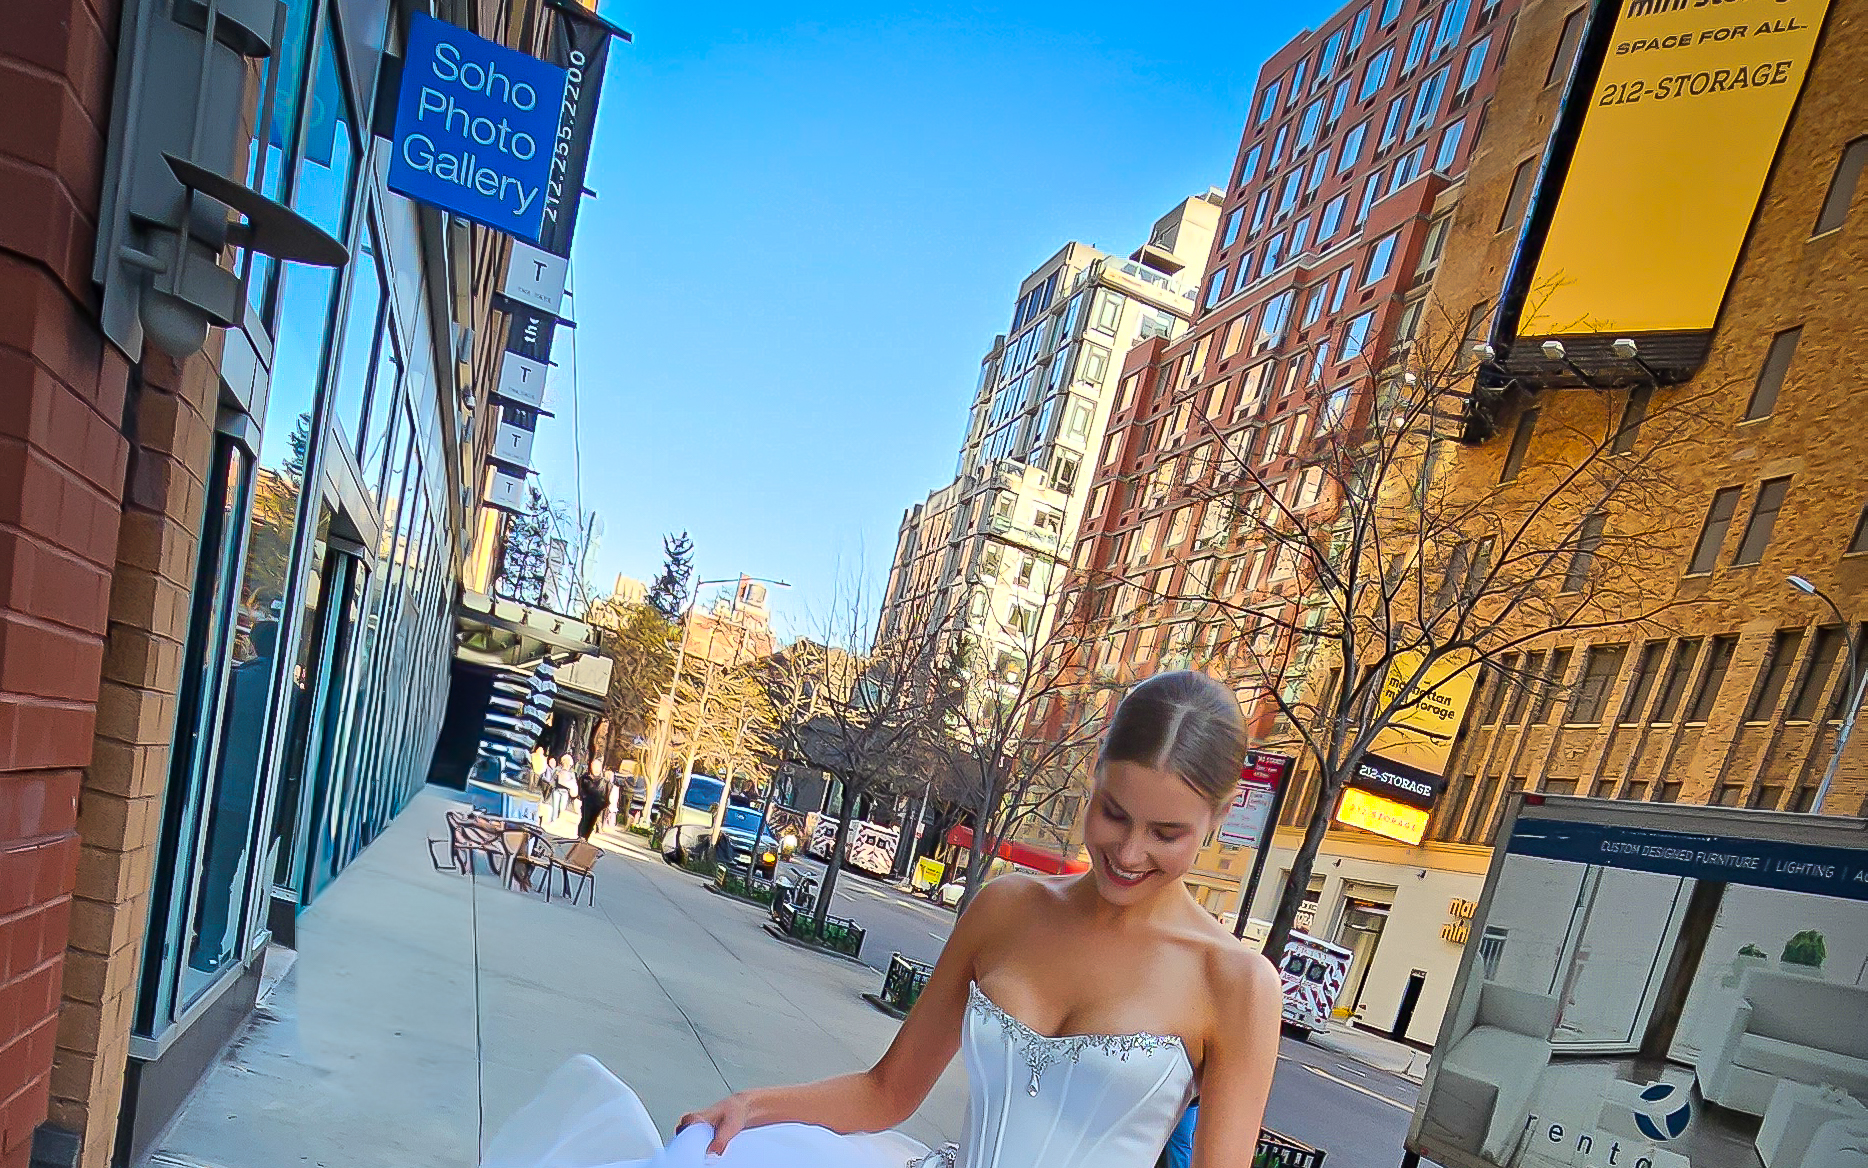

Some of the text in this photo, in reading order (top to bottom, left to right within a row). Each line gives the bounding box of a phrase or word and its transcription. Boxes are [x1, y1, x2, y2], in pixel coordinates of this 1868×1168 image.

[1616, 33, 1694, 56] SPACE
[1698, 25, 1749, 45] FOR
[432, 43, 537, 111] Soho
[1599, 60, 1793, 107] 212-STORAGE
[418, 86, 536, 161] Photo
[544, 50, 586, 223] 212.255.2200
[403, 133, 539, 216] Gallery
[533, 258, 548, 282] T
[520, 365, 532, 383] T
[511, 433, 522, 448] T
[1358, 764, 1432, 797] 212-STORAGE
[1600, 840, 1641, 855] CUSTOM
[1641, 845, 1694, 862] DESIGNED
[1695, 851, 1761, 870] FURNITURE
[1776, 860, 1836, 878] LIGHTING
